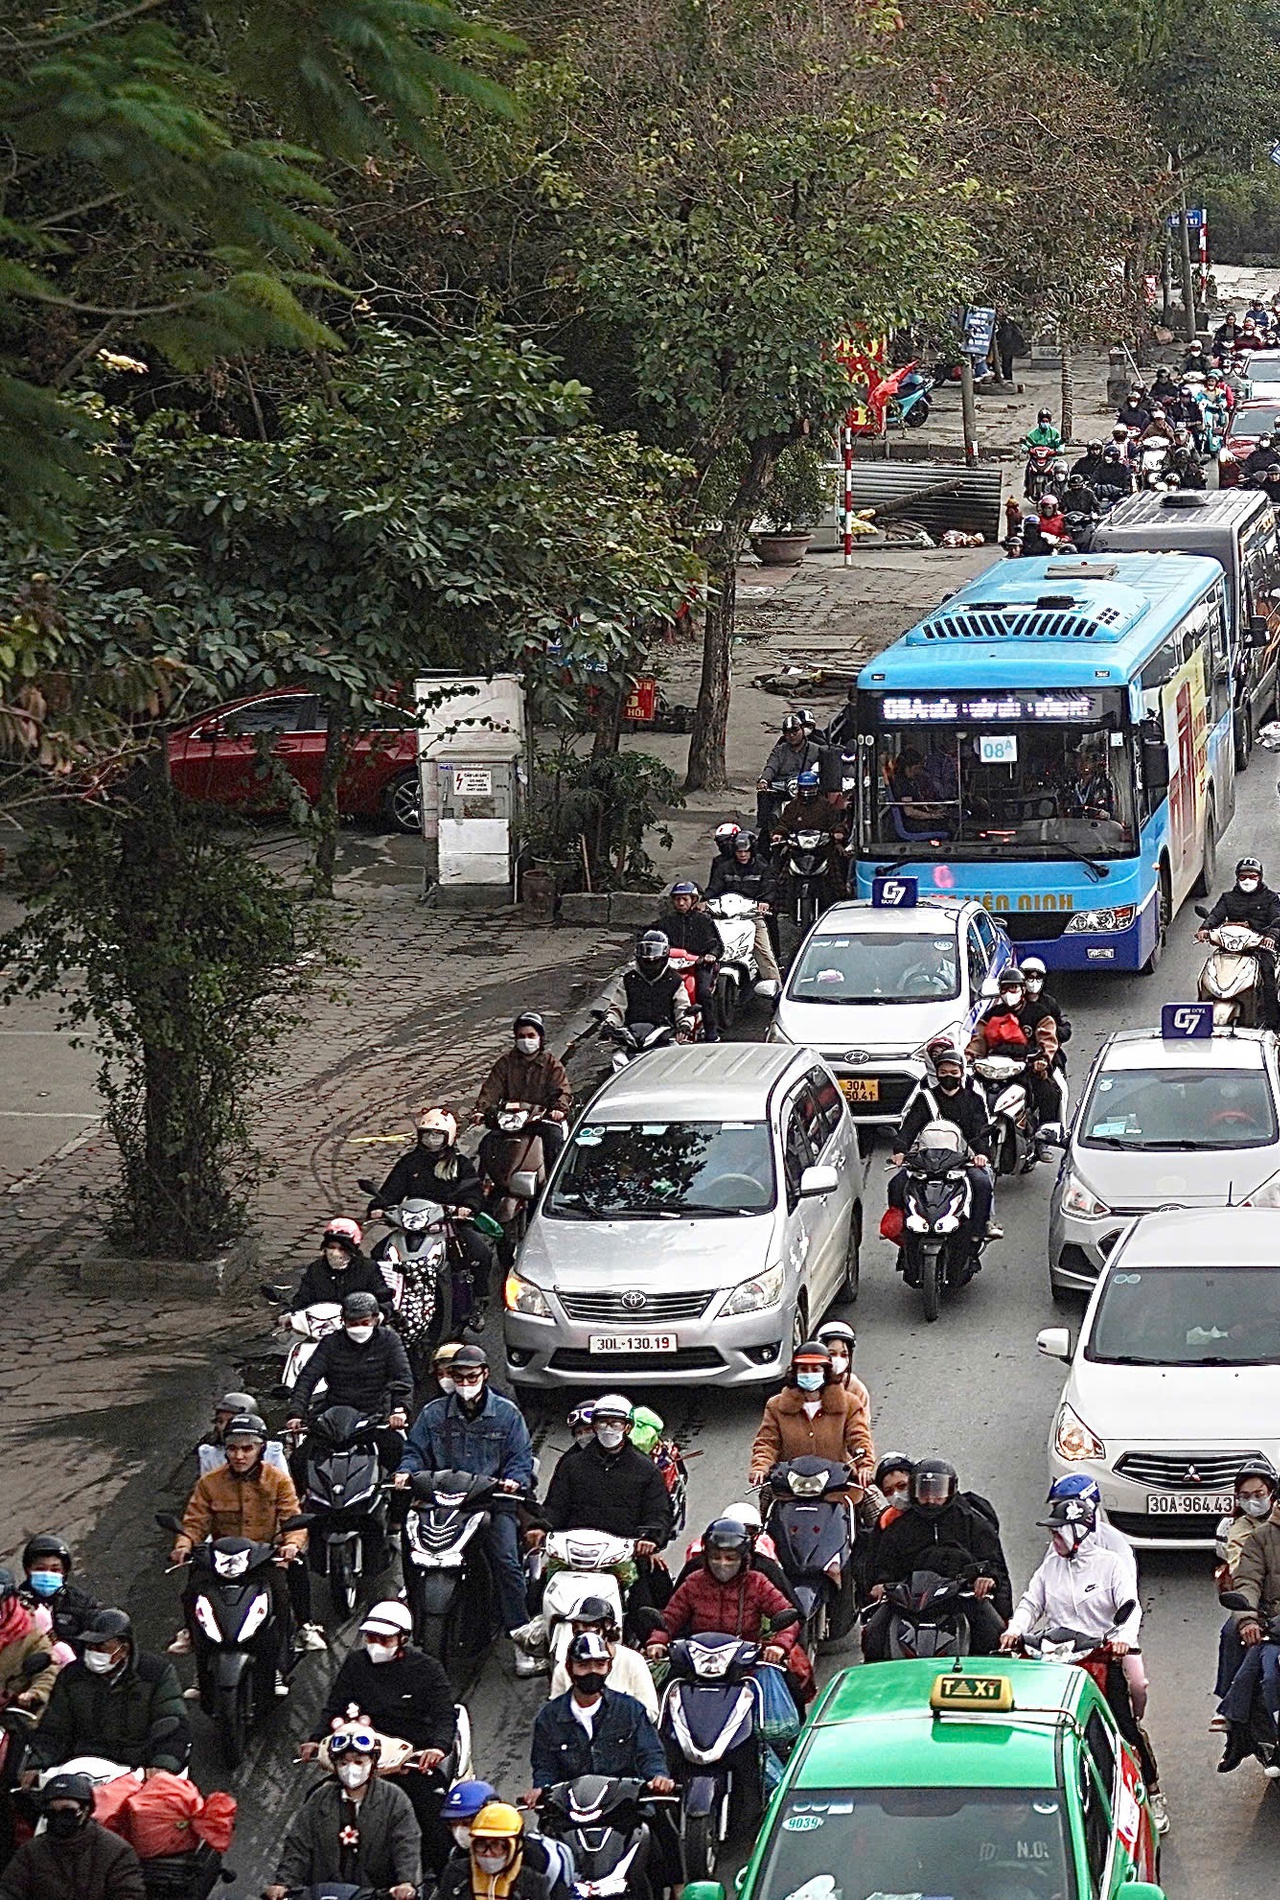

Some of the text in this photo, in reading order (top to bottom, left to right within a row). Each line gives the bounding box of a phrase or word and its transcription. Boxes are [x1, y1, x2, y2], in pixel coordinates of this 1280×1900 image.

[883, 881, 906, 905] G7
[597, 1336, 670, 1350] 30L-130.19
[1150, 1496, 1233, 1513] 30A-964.43
